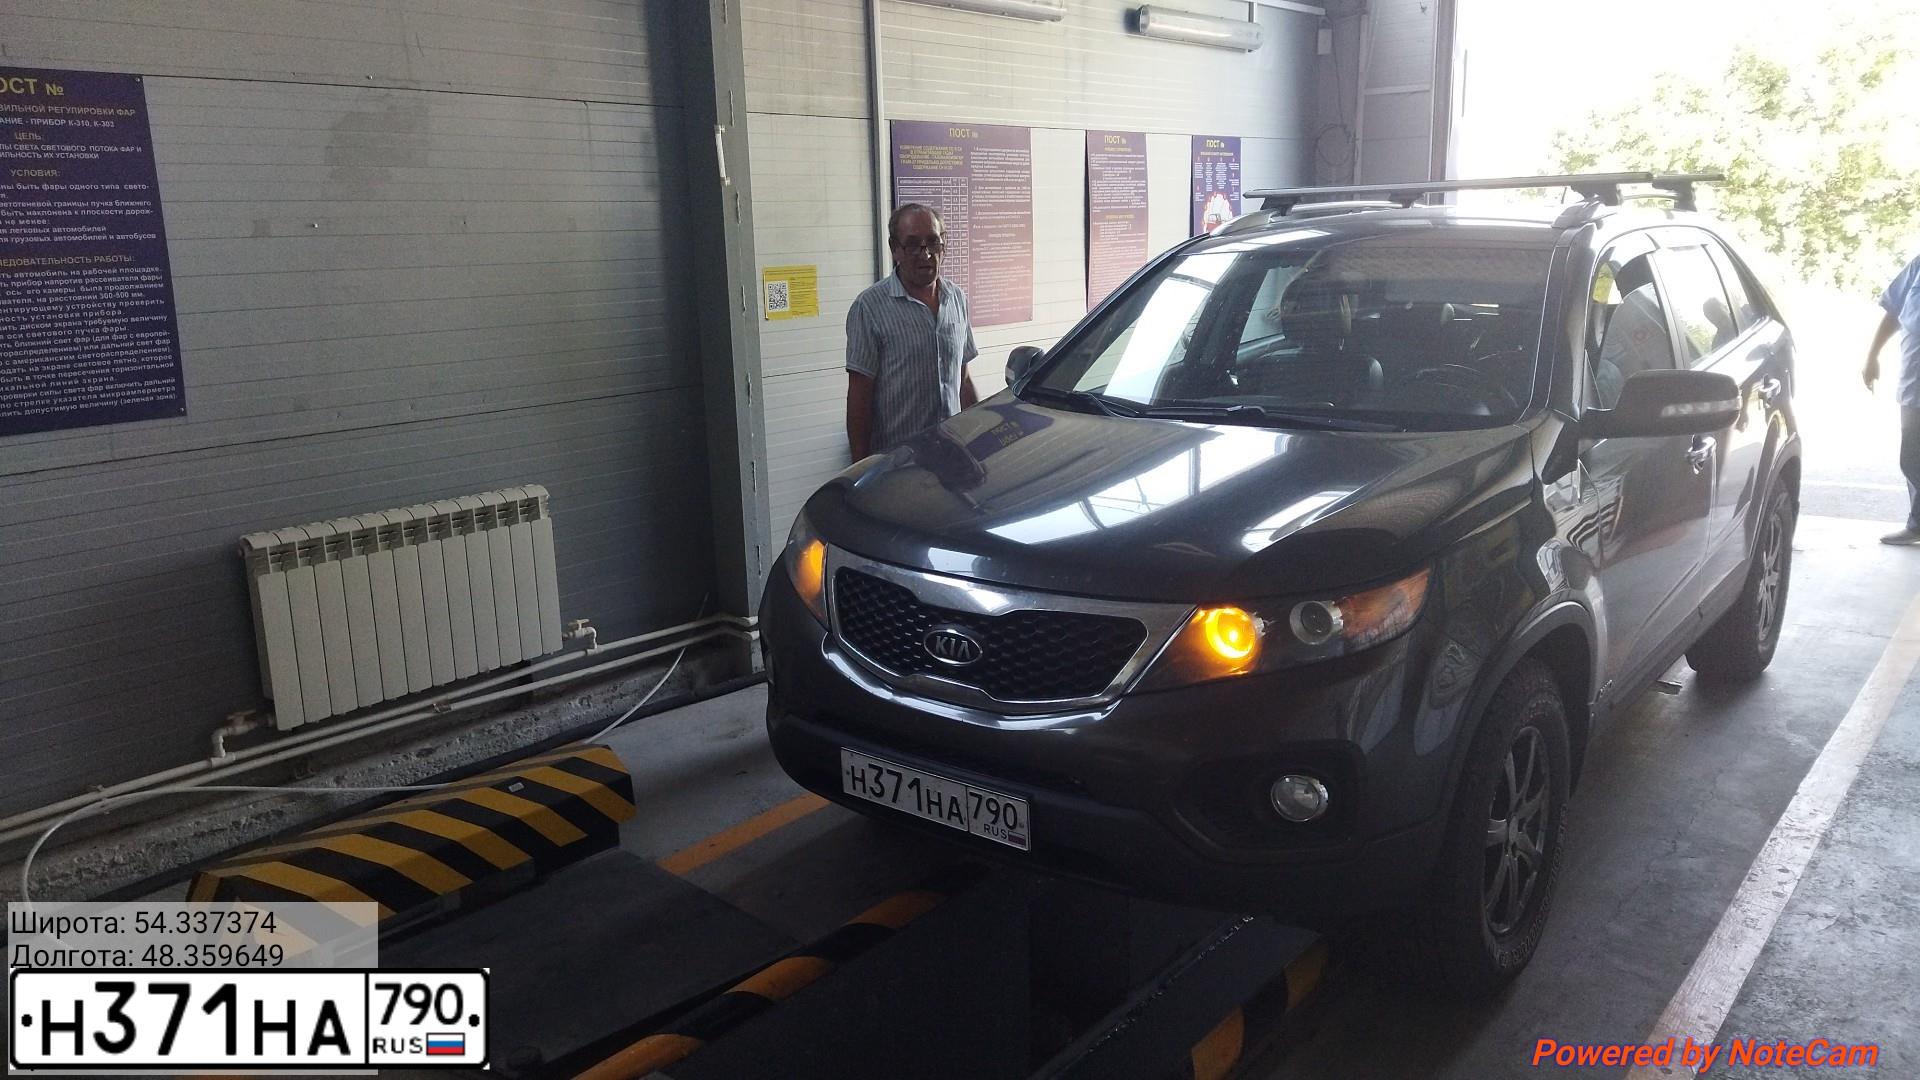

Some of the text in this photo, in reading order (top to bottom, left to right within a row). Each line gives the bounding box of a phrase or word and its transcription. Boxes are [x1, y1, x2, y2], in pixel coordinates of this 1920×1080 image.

[46, 83, 64, 95] №
[48, 106, 115, 116] РЕГУЛИРОВКИ
[117, 108, 136, 116] ФАР
[949, 128, 970, 137] ПОСТ
[1104, 135, 1120, 144] ПОСТ
[1206, 140, 1219, 148] ПОСТ
[42, 183, 67, 191] фары
[54, 200, 88, 208] границы
[935, 636, 971, 659] KIA
[850, 764, 1018, 830] Н371НА 790
[984, 824, 1008, 840] RUS
